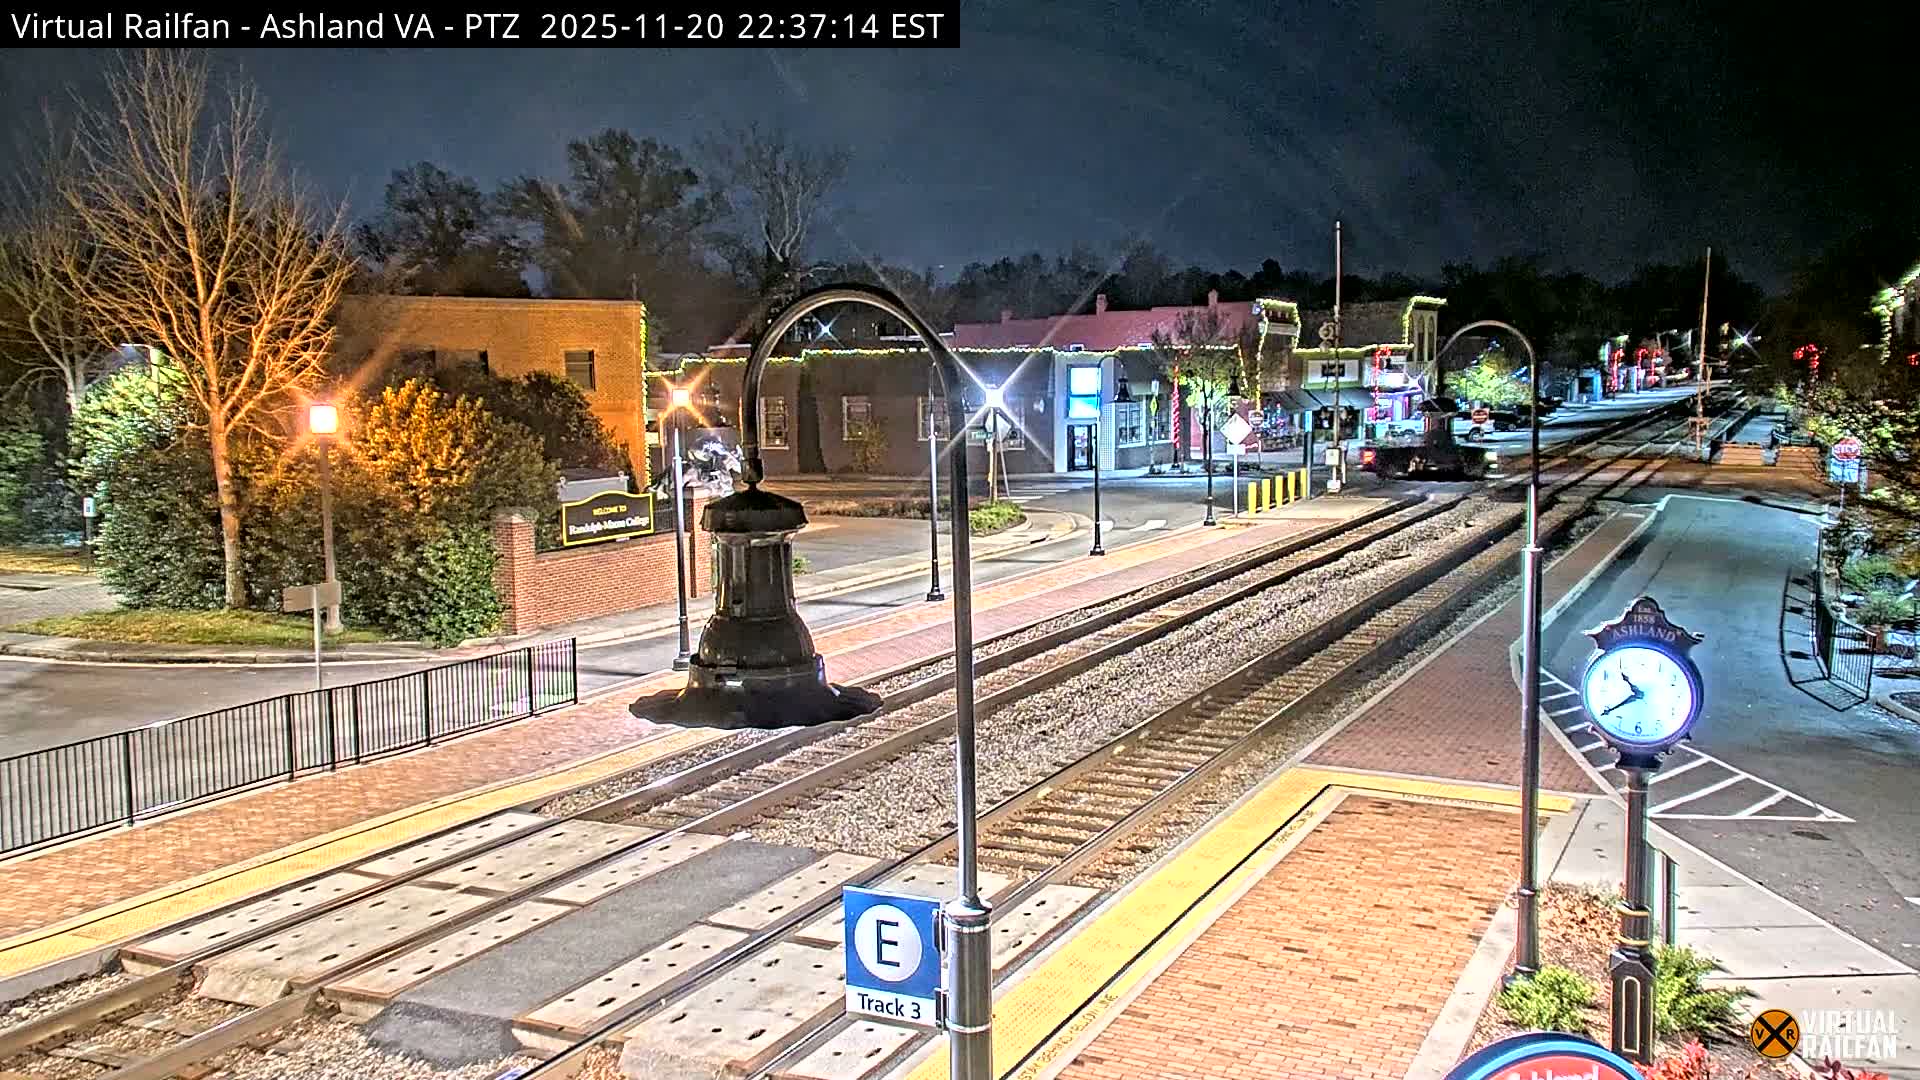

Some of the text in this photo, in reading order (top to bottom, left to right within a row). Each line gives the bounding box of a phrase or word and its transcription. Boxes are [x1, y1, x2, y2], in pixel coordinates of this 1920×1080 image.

[1613, 624, 1676, 642] ASHLAND
[1634, 720, 1643, 735] 6
[876, 919, 900, 967] E
[857, 992, 921, 1020] Track 3
